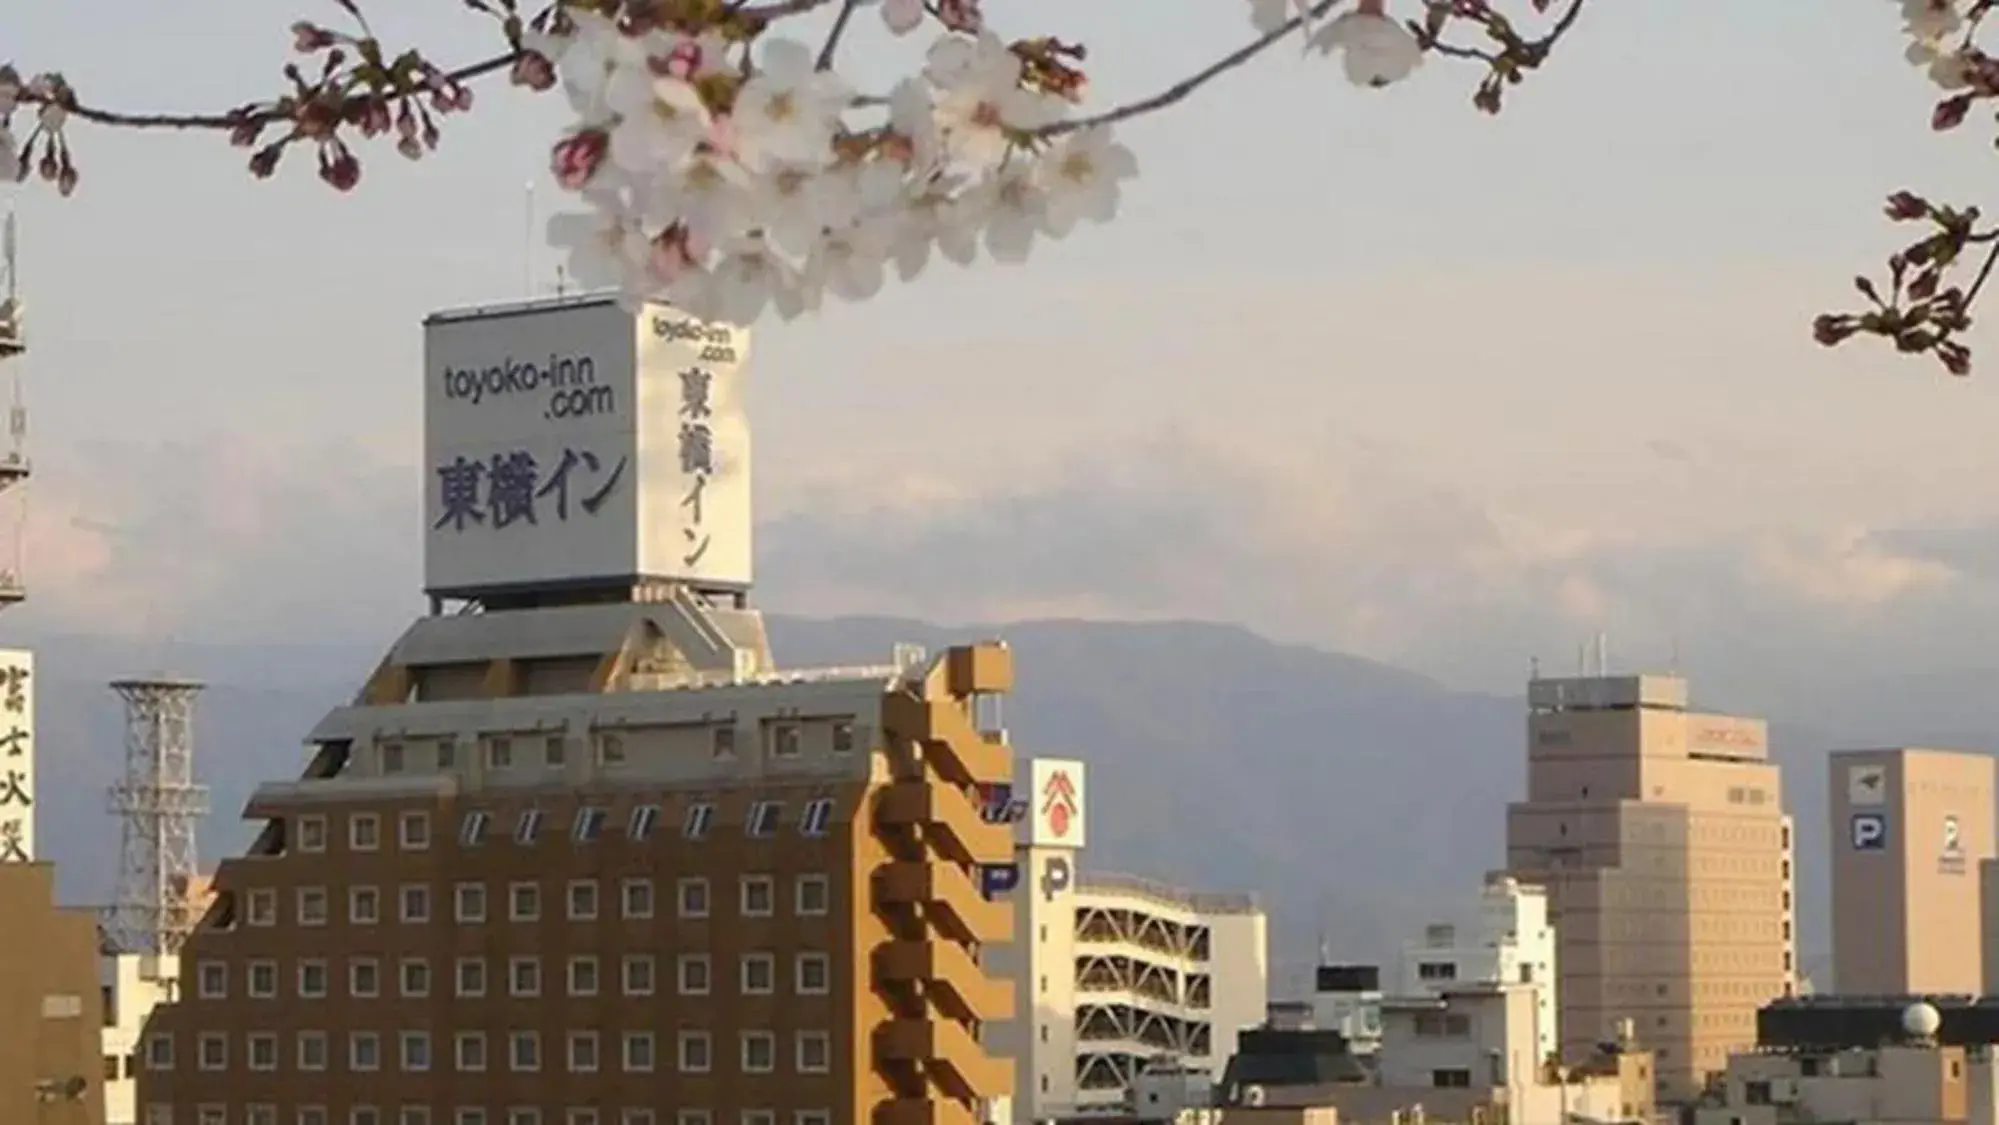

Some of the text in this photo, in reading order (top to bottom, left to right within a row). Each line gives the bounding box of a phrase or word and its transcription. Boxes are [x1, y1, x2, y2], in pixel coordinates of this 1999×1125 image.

[444, 354, 595, 405] toyoko-inn
[543, 384, 614, 420] .com
[678, 366, 714, 566] 東横イン
[433, 448, 628, 534] 東横イン
[1854, 818, 1882, 846] P
[1041, 857, 1069, 902] P
